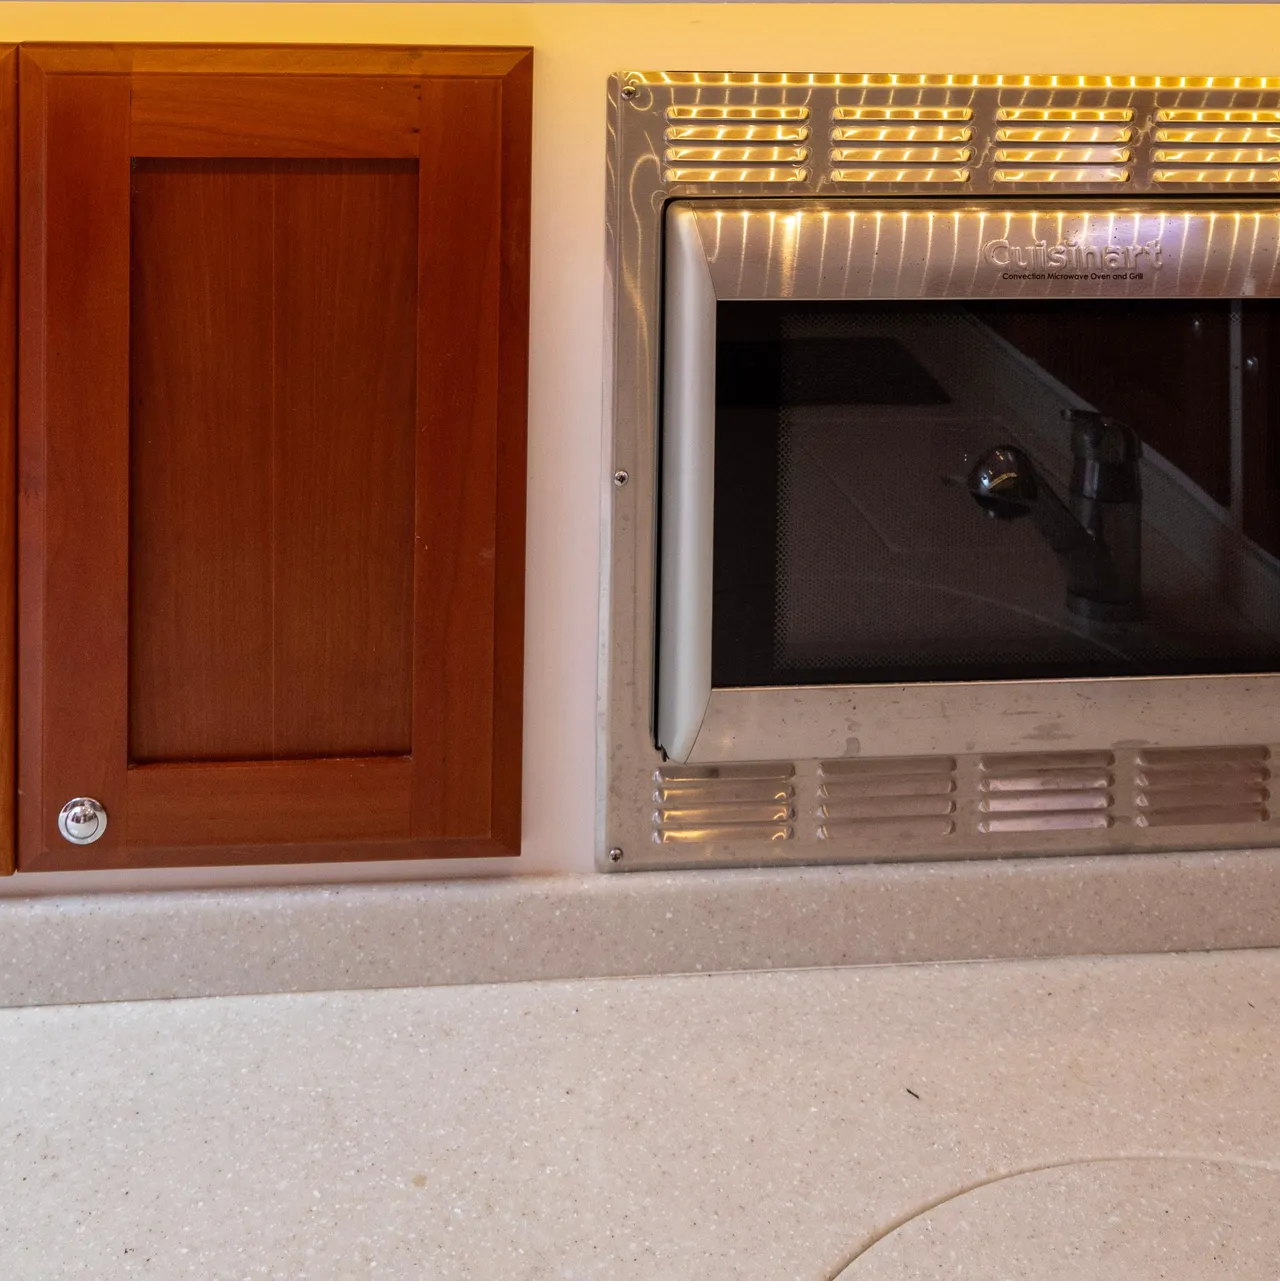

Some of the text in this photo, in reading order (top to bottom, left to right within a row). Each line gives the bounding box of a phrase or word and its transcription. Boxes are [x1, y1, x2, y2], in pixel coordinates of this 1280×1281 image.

[981, 238, 1164, 271] Cuisinart
[1003, 272, 1144, 280] Convection Microwave Oven and Grill
